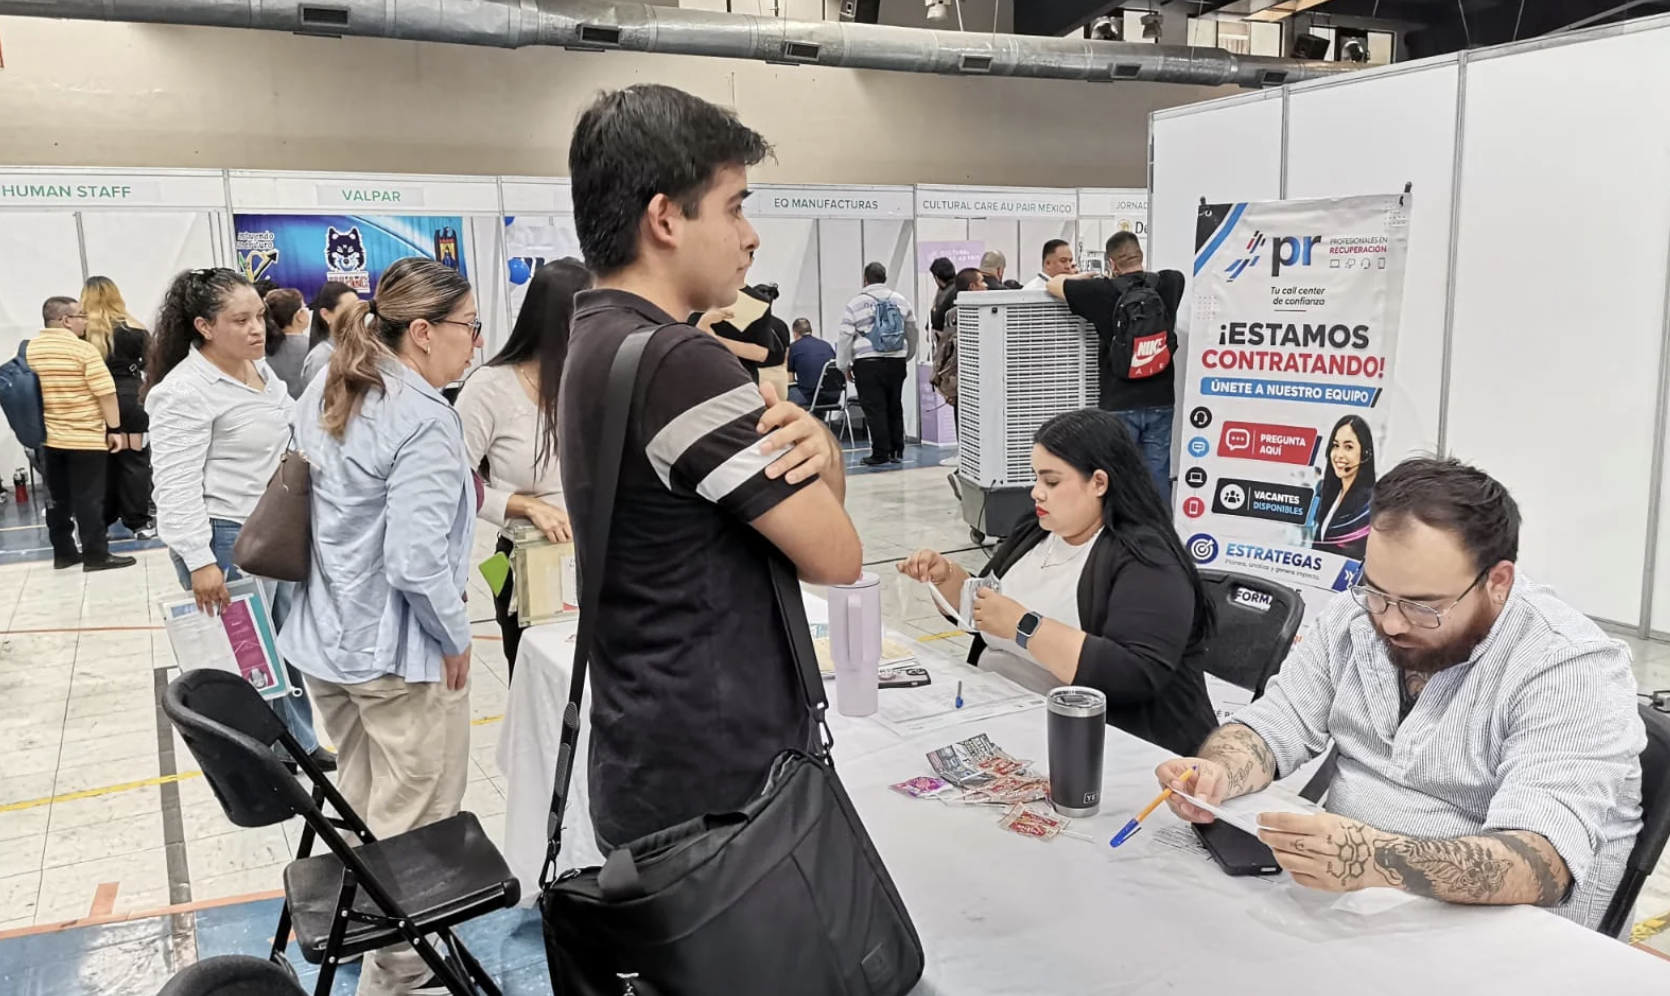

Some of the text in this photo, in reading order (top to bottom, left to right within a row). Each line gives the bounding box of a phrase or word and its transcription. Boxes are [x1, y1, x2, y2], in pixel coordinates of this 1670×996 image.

[1, 184, 131, 198] HUMAN STAFF
[342, 189, 401, 202] VALPAR
[774, 198, 879, 210] EQ MANUFACTURAS
[922, 200, 971, 210] CULTURAL
[973, 201, 998, 211] CARE
[1000, 203, 1014, 212] AU
[1016, 203, 1036, 213] PAIR
[1271, 235, 1322, 277] pr
[1329, 245, 1387, 254] RECUPERACIÓN
[1270, 286, 1326, 295] Tu call center
[1272, 296, 1326, 306] de confianza
[1218, 322, 1370, 349] ¡ESTAMOS
[1138, 338, 1165, 356] NIKE
[1201, 349, 1385, 379] CONTRATANDO!
[1210, 378, 1369, 403] ÚNETE A NUESTRO EQUIPO
[1260, 433, 1307, 448] PREGUNTA
[1259, 445, 1282, 457] AQUÍ
[1254, 490, 1301, 505] VACANTES
[1252, 501, 1304, 517] DISPONIBLES
[1226, 543, 1323, 571] ESTRATEGAS
